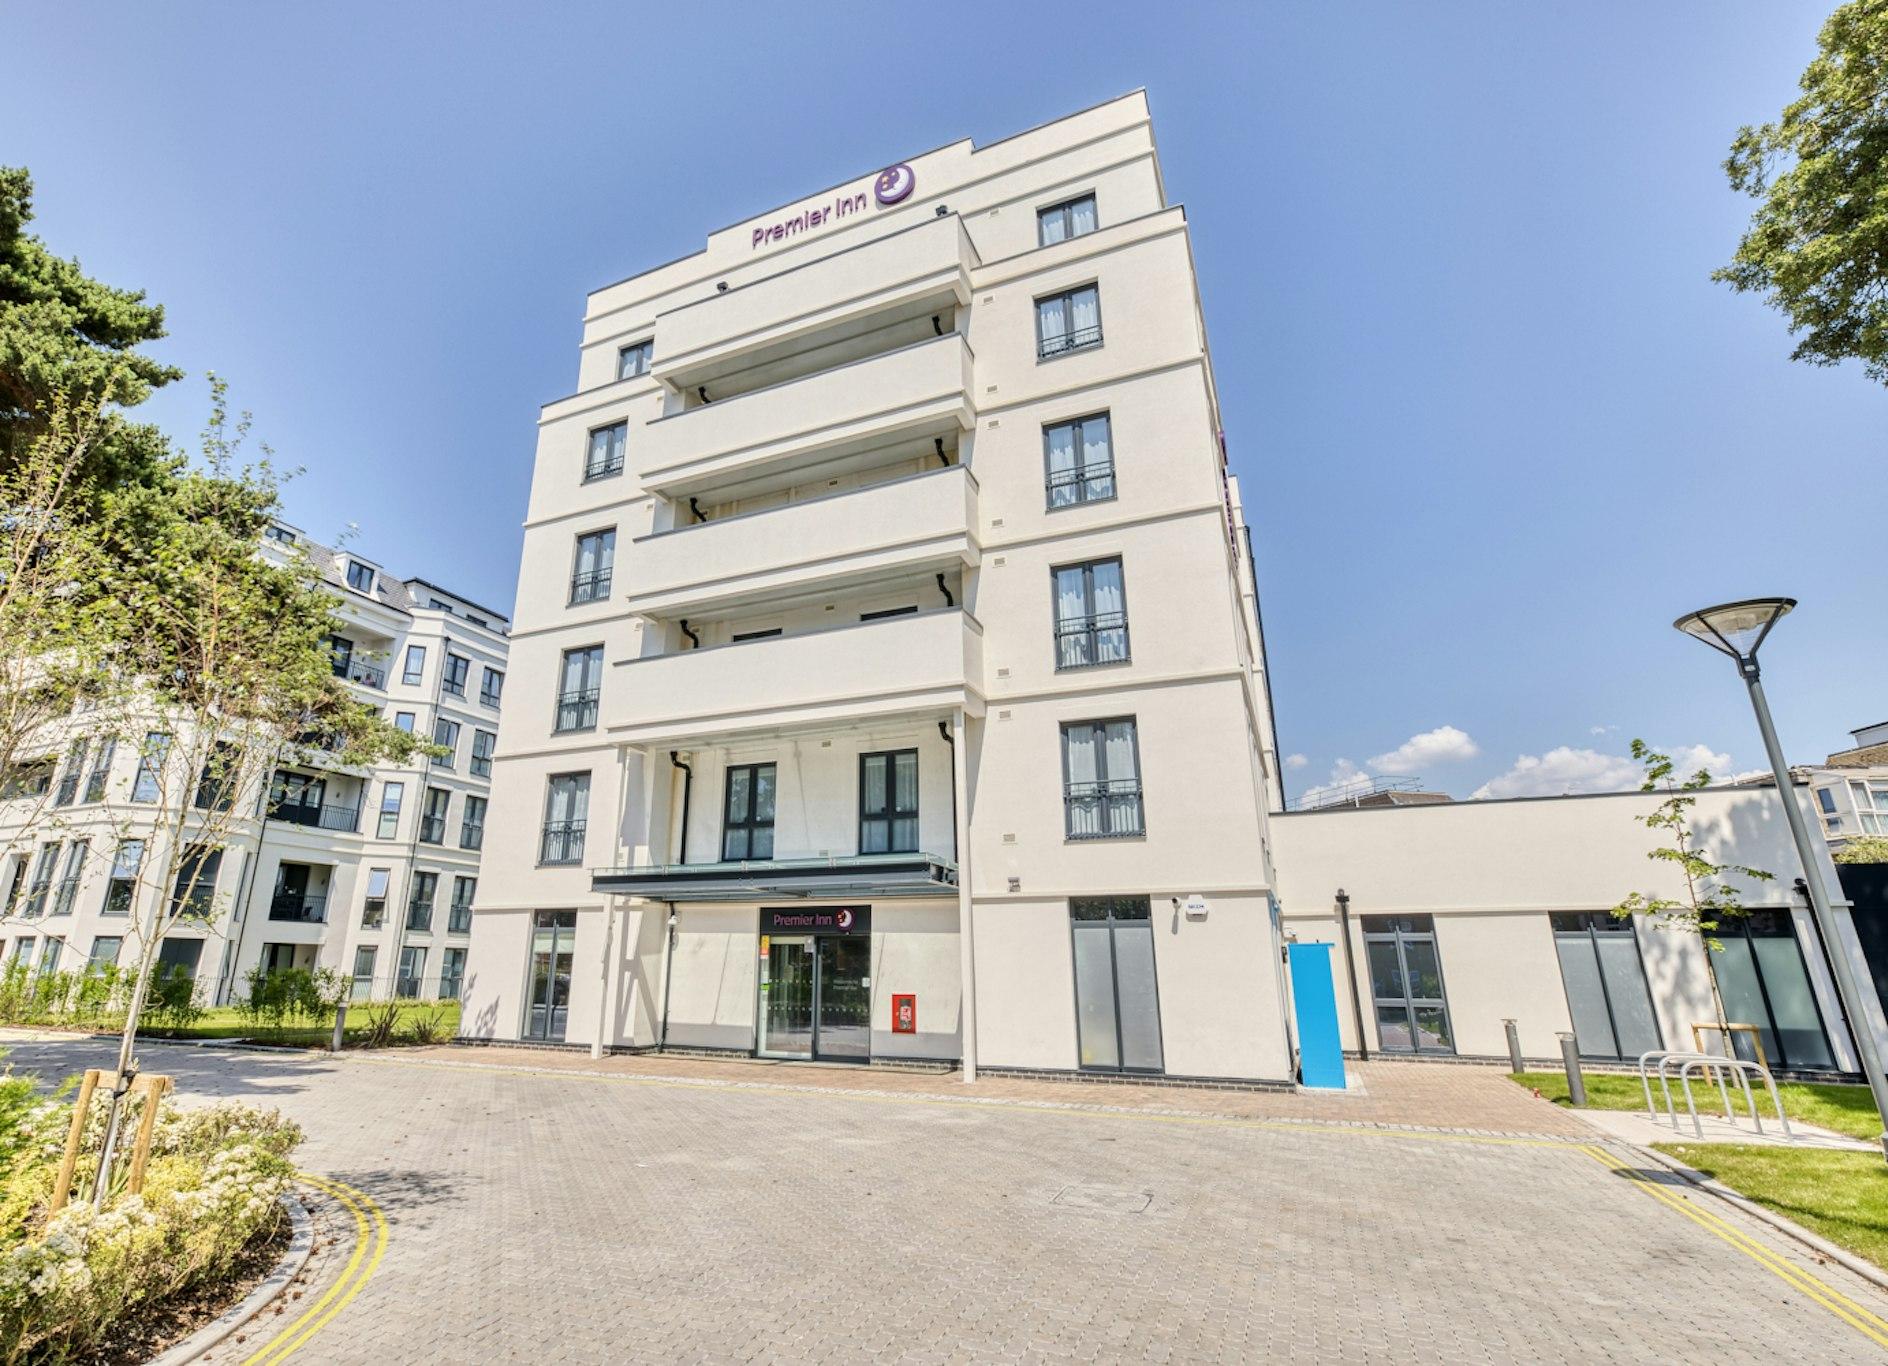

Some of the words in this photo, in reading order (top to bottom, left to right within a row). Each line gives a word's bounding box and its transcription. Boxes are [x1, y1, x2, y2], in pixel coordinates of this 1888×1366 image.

[752, 204, 831, 249] Premier
[835, 192, 867, 219] Inn
[773, 913, 813, 926] Premier
[815, 913, 833, 925] Inn
